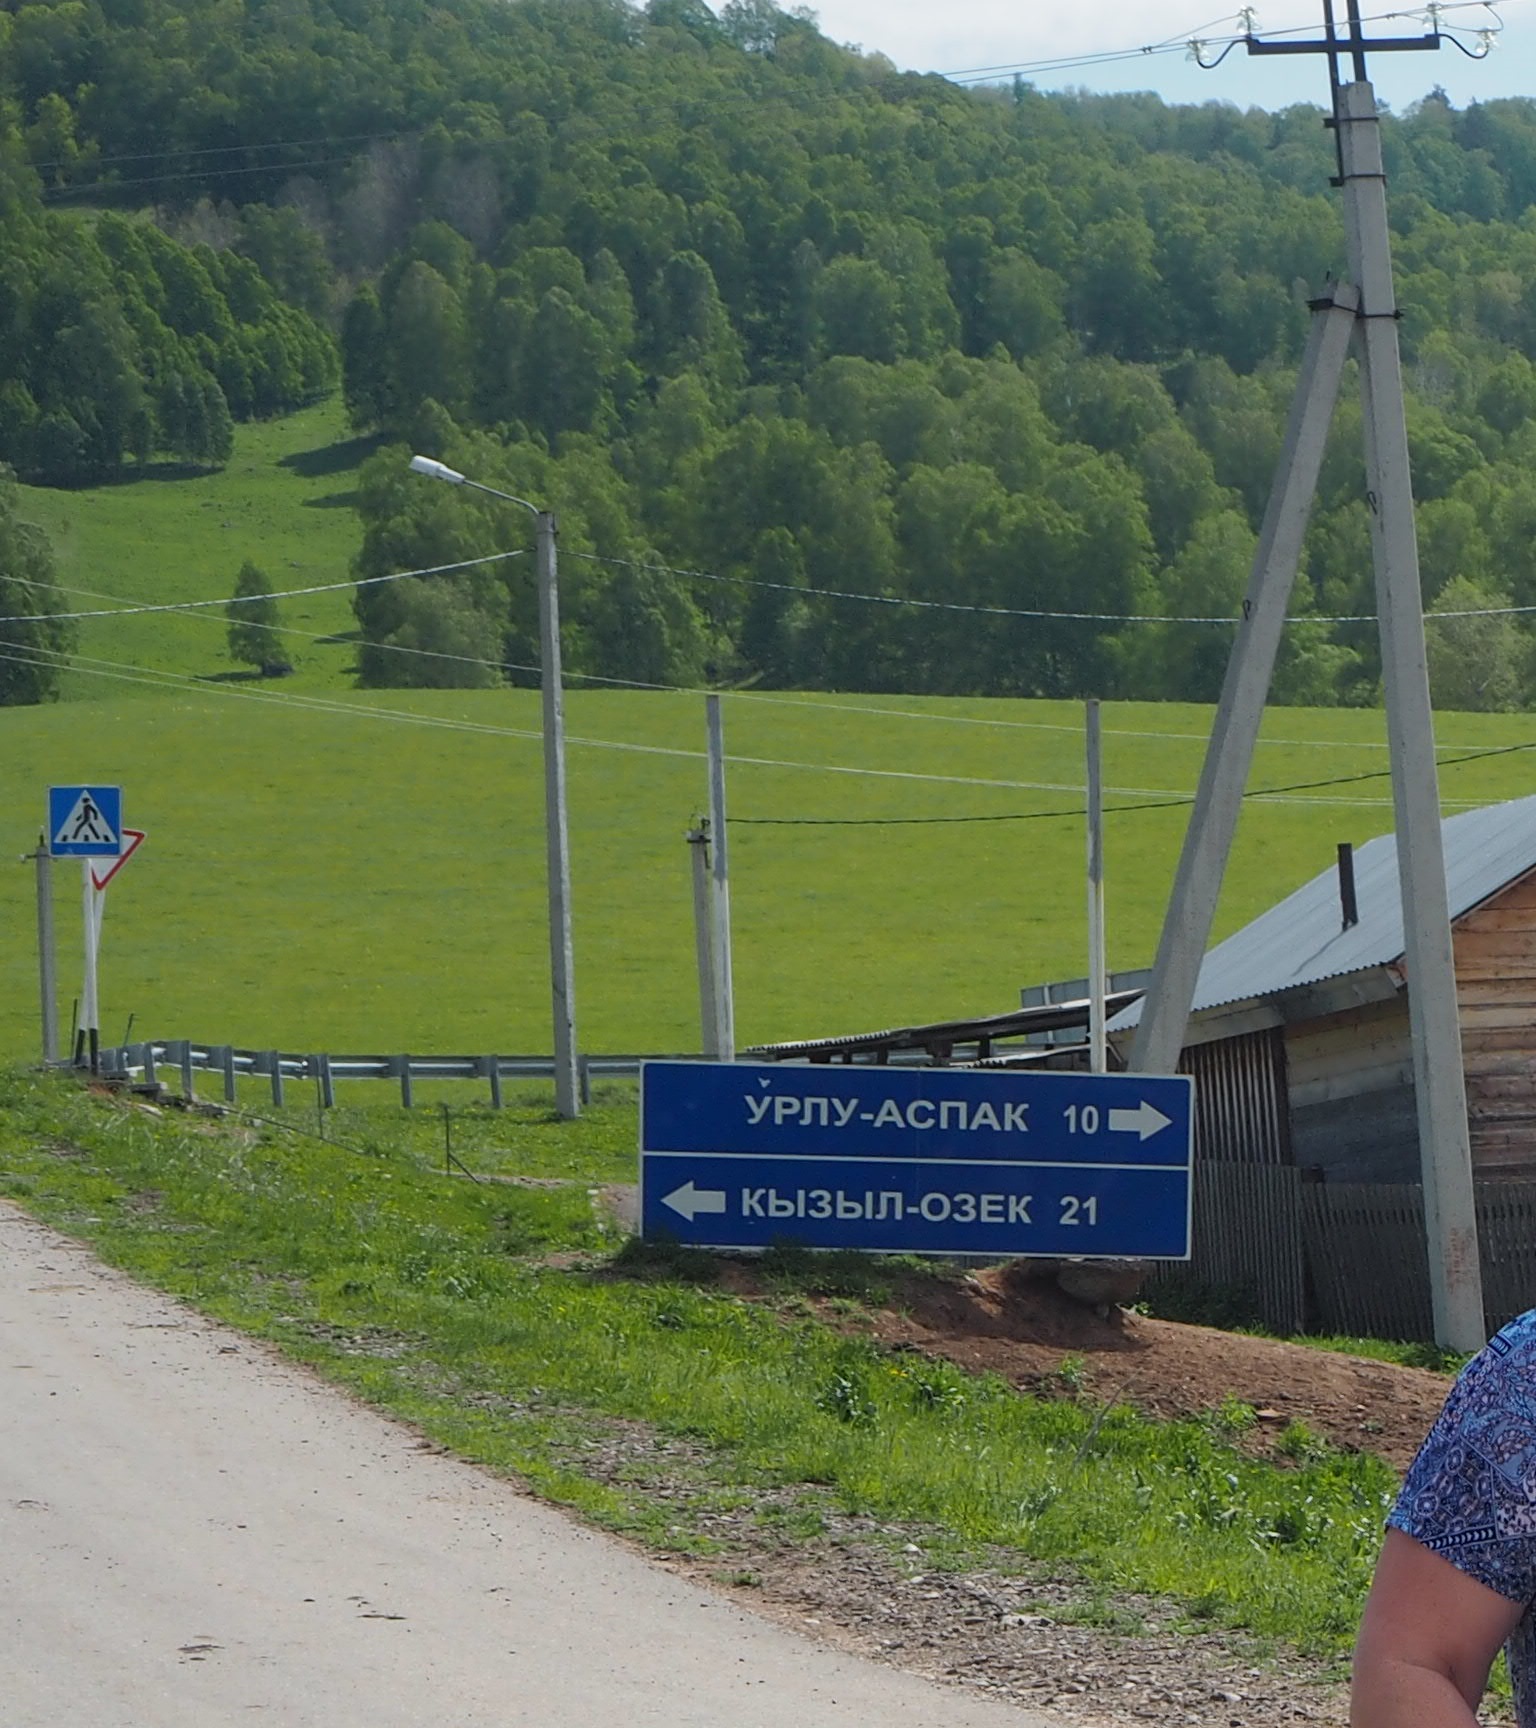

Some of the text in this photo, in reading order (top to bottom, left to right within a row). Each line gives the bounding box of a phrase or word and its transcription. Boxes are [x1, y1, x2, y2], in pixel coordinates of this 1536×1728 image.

[744, 1095, 1099, 1135] УРЛУ-АСПАК 10
[741, 1188, 1098, 1226] КЫЗЫЛ-ОЗЕК 21
